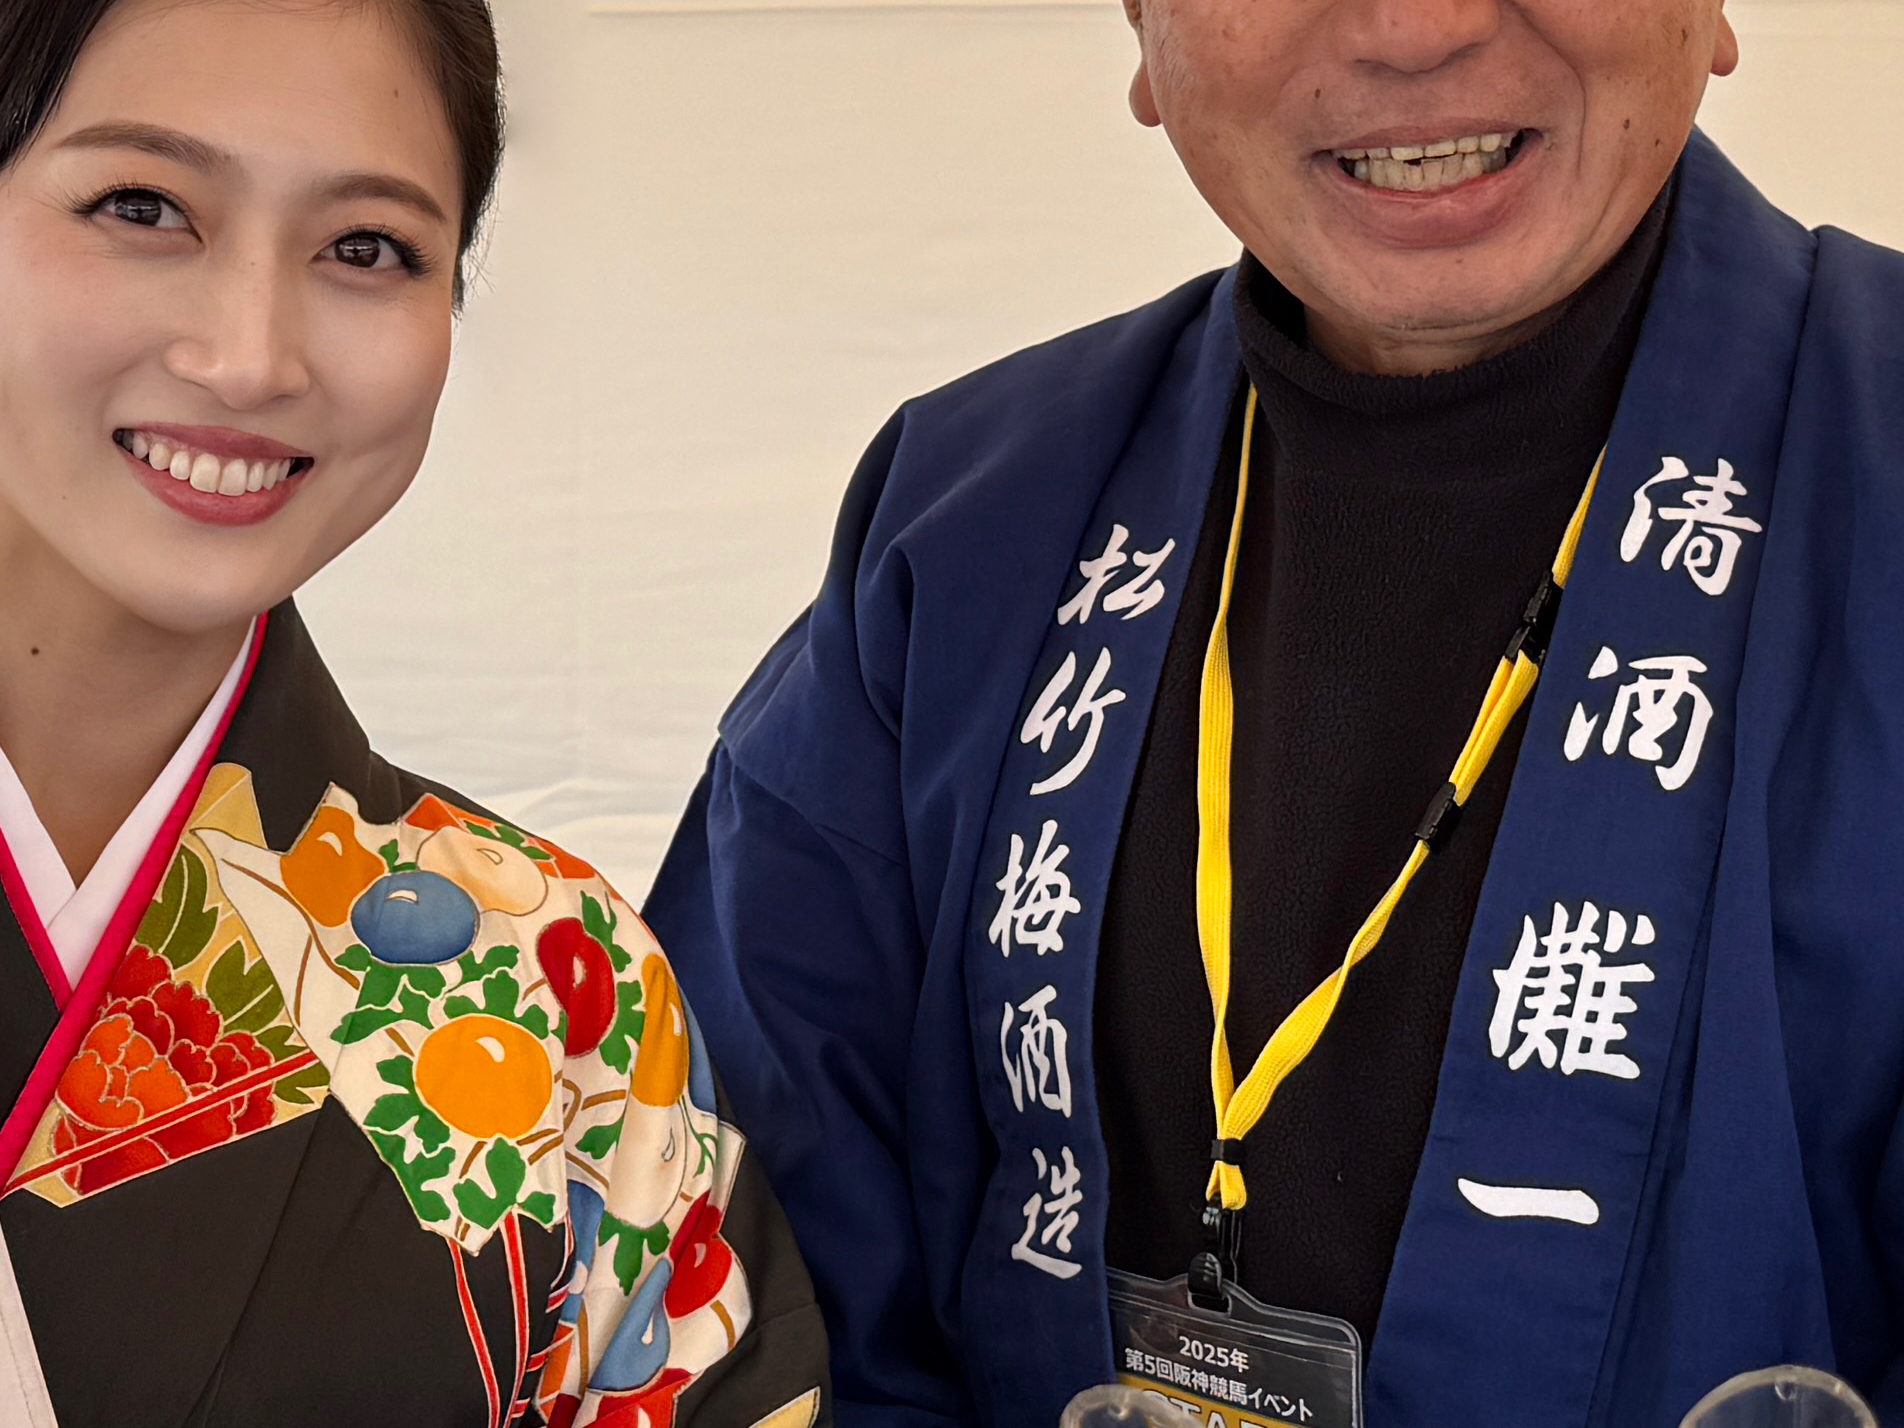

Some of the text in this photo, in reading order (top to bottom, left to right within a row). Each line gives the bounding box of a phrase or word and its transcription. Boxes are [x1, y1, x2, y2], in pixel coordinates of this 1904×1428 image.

[988, 524, 1176, 1279] 松竹梅酒造
[1125, 1347, 1313, 1422] 第5回阪神競馬イベント
[1178, 1335, 1250, 1373] 2025年
